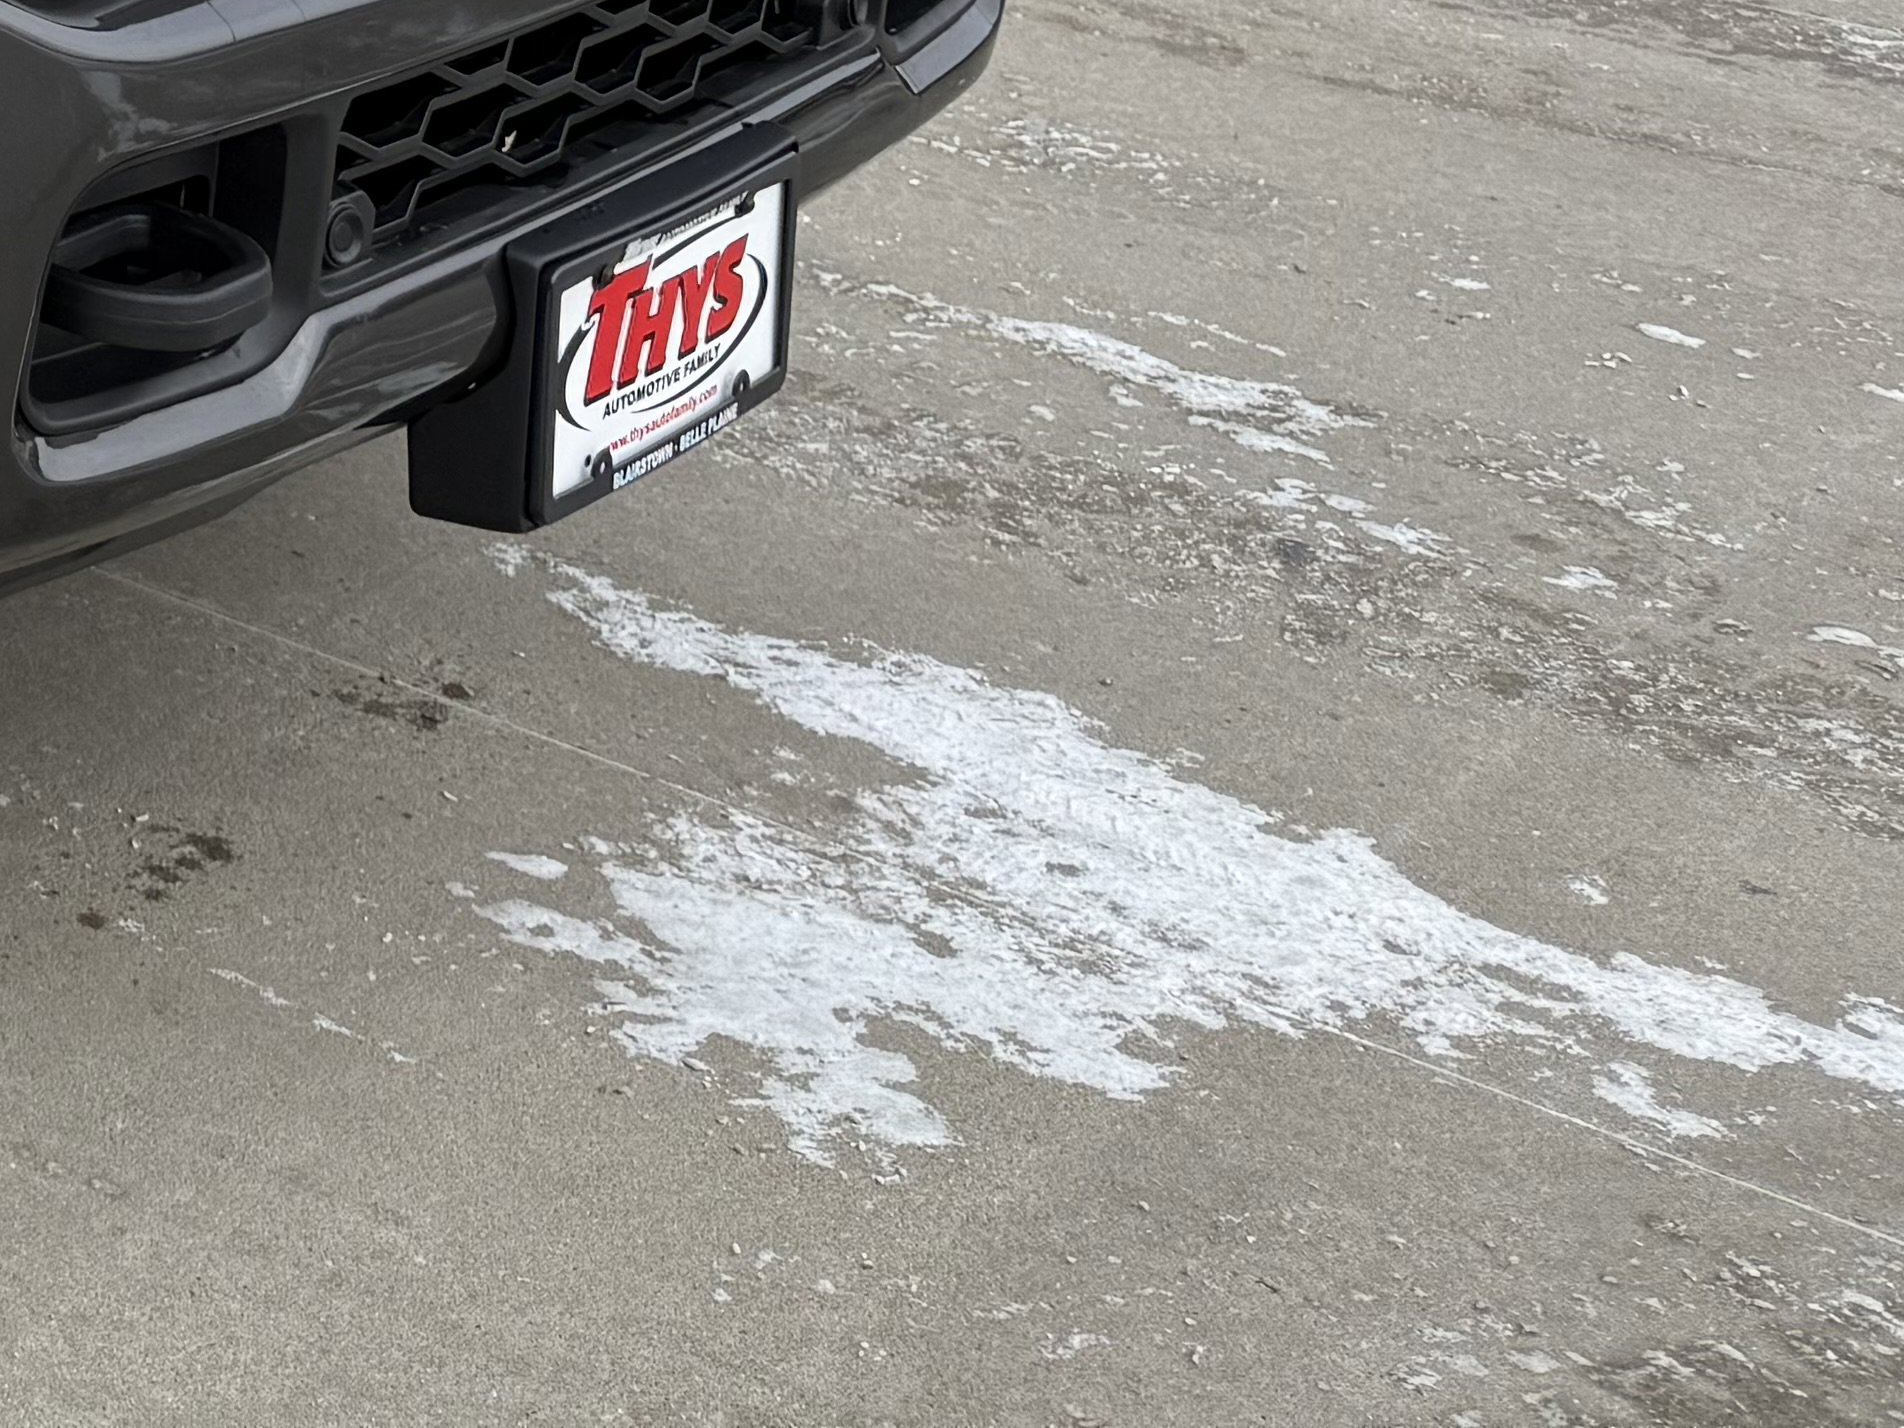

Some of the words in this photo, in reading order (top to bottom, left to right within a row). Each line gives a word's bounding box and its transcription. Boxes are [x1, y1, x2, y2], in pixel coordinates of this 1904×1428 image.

[583, 232, 750, 407] THYS
[602, 366, 682, 421] AUTOMOTIVE
[682, 342, 722, 378] FAMILY
[609, 383, 718, 452] ww.thysautofamily.com
[613, 441, 674, 491] BLAIRSTOWN
[678, 421, 708, 453] BELLE
